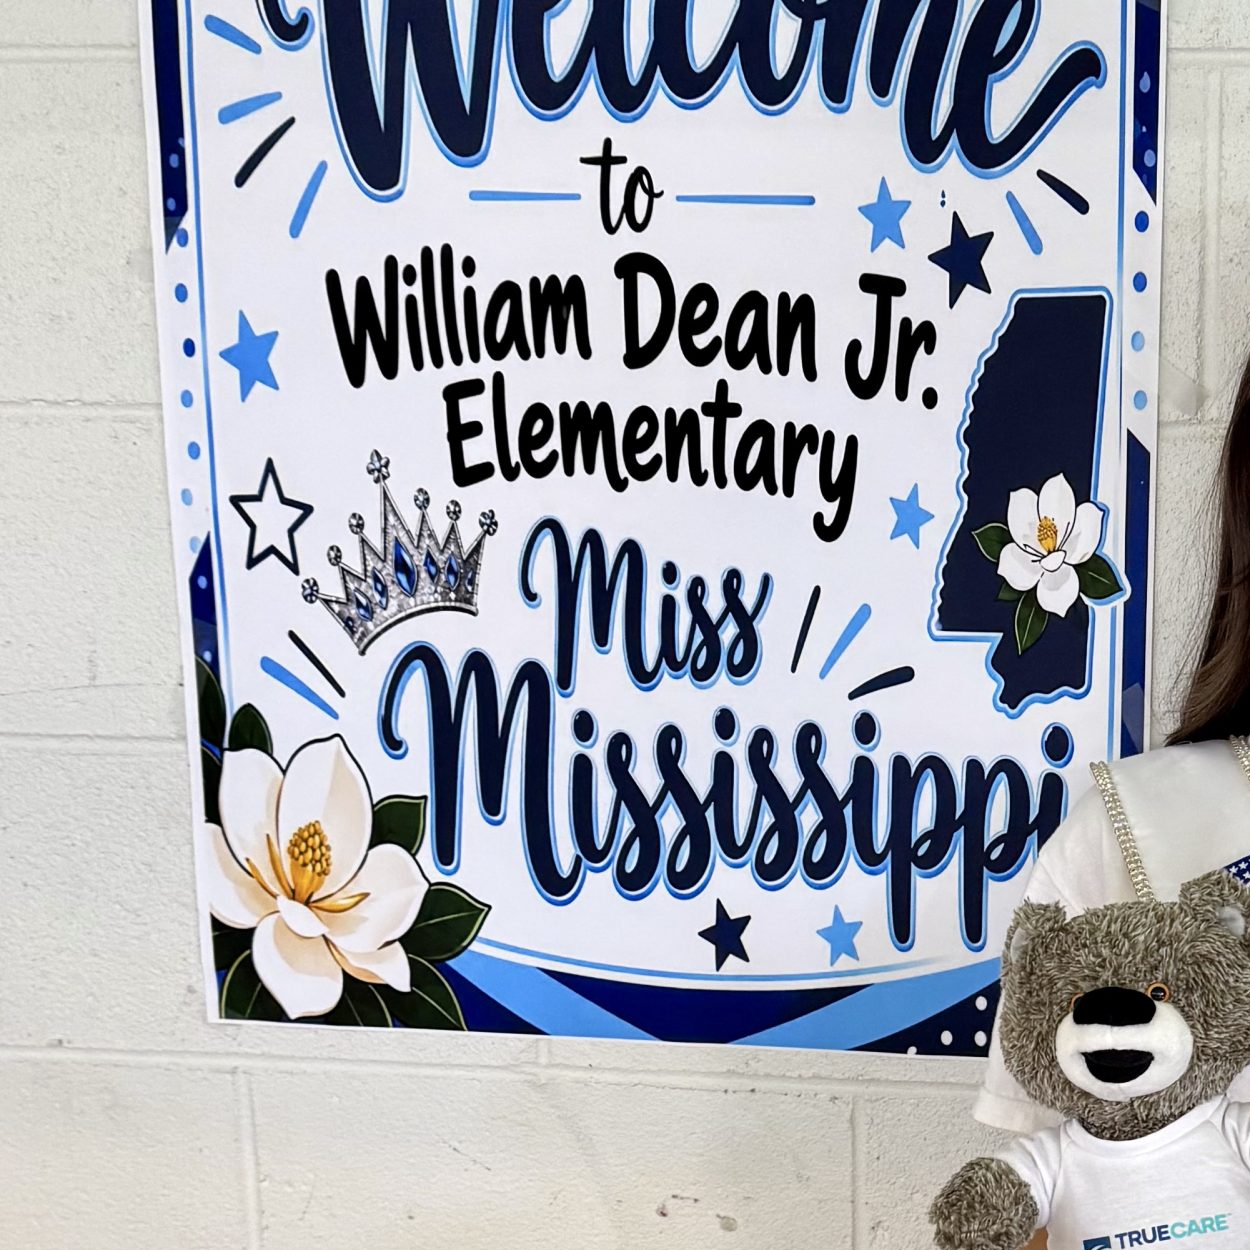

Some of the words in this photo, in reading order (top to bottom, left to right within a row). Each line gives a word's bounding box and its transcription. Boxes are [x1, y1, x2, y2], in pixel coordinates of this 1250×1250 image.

[579, 137, 666, 236] to
[325, 243, 593, 389] William
[613, 251, 818, 383] Dean
[844, 272, 940, 410] Jr.
[442, 370, 859, 543] Elementary
[519, 514, 774, 697] Miss
[378, 642, 1074, 952] Mississippi
[1114, 1213, 1231, 1250] TRUECARE
